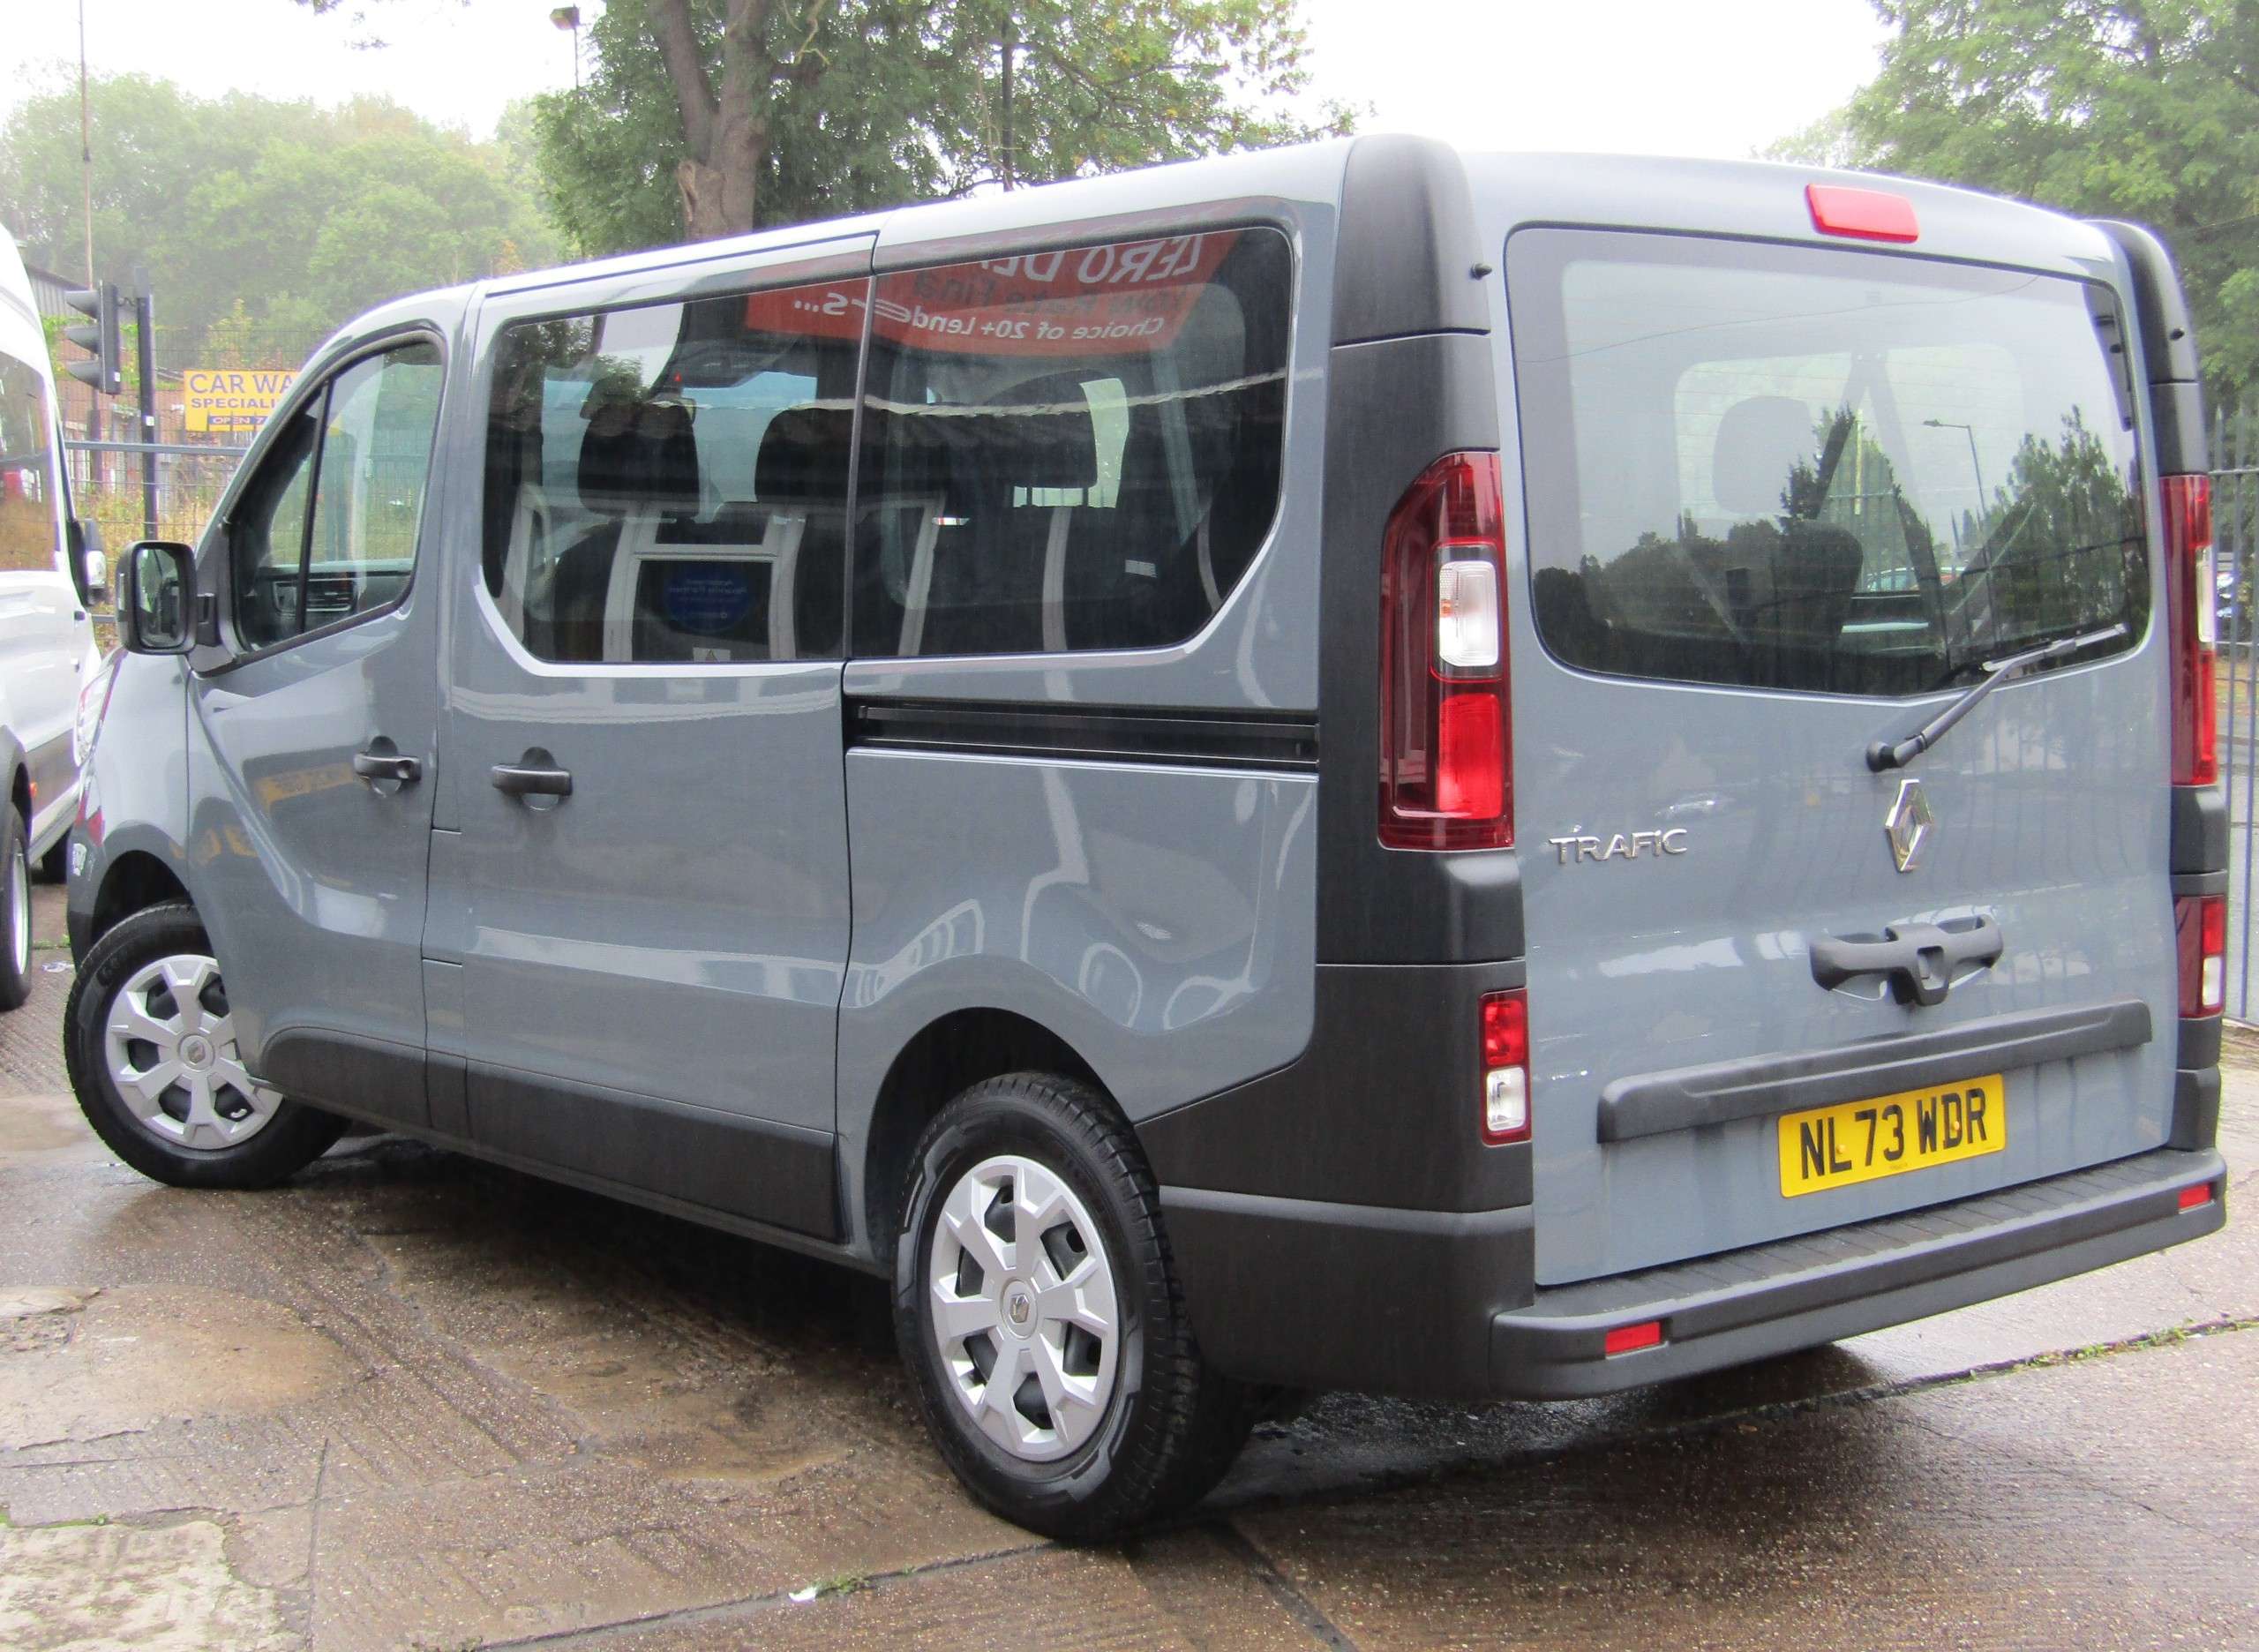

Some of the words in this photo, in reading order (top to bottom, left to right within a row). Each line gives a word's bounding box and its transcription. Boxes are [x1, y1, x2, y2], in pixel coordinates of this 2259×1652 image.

[190, 373, 245, 394] CAR
[1548, 828, 1688, 864] TRAFIC
[1800, 1115, 1852, 1180] NL
[1854, 1104, 1905, 1167] 73
[1917, 1087, 1988, 1155] WDR
